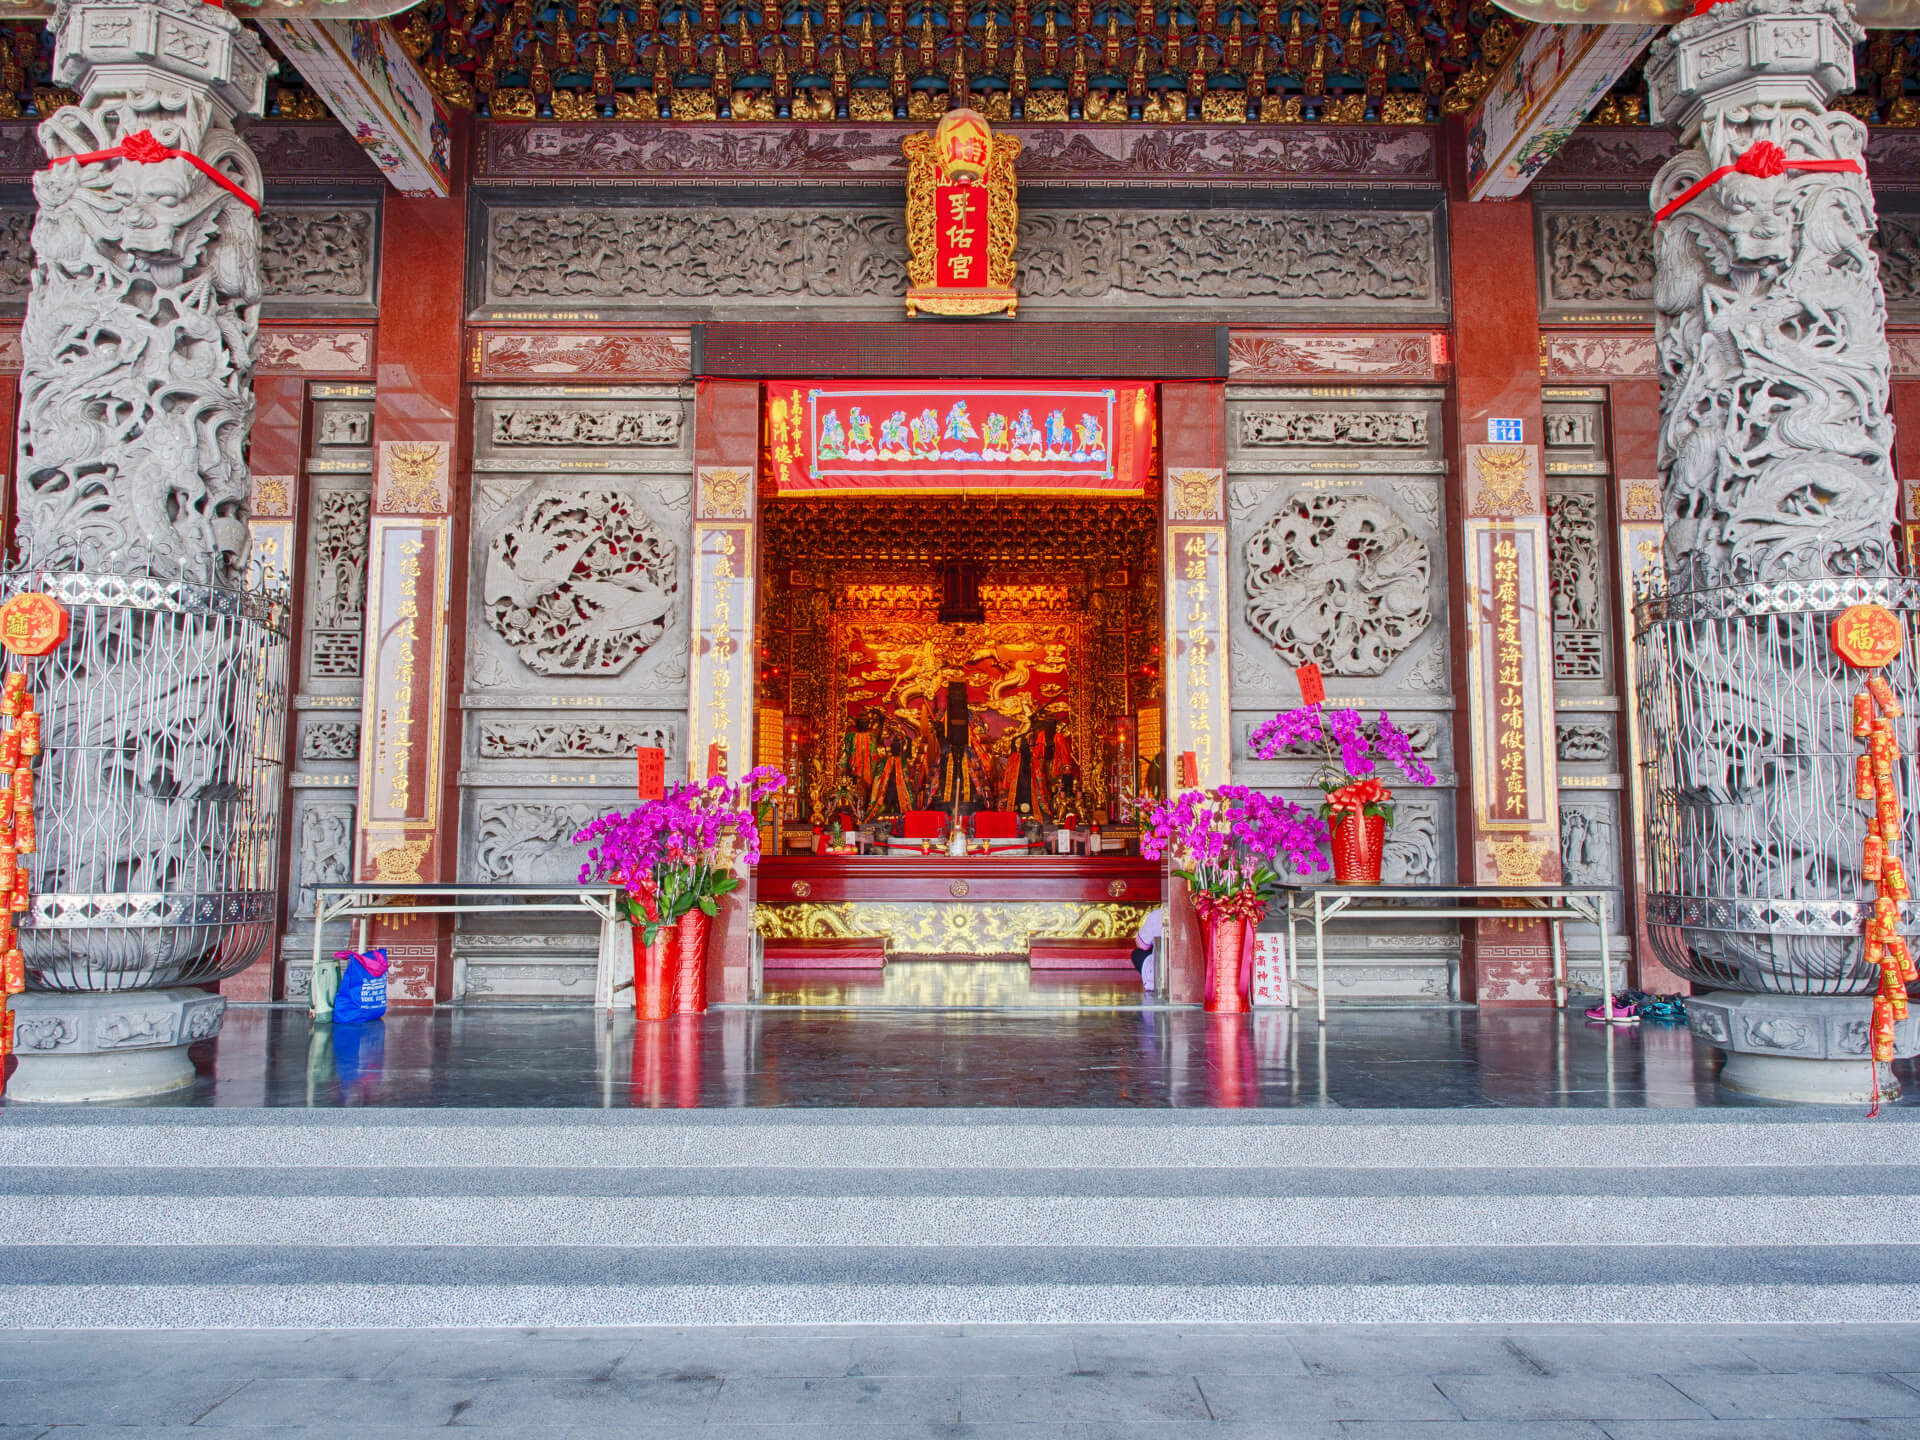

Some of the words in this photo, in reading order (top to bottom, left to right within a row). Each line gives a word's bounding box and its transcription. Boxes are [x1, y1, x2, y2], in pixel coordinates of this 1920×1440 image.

[945, 193, 976, 279] 孚佑宮
[1501, 429, 1516, 440] 14
[1847, 622, 1875, 650] 福
